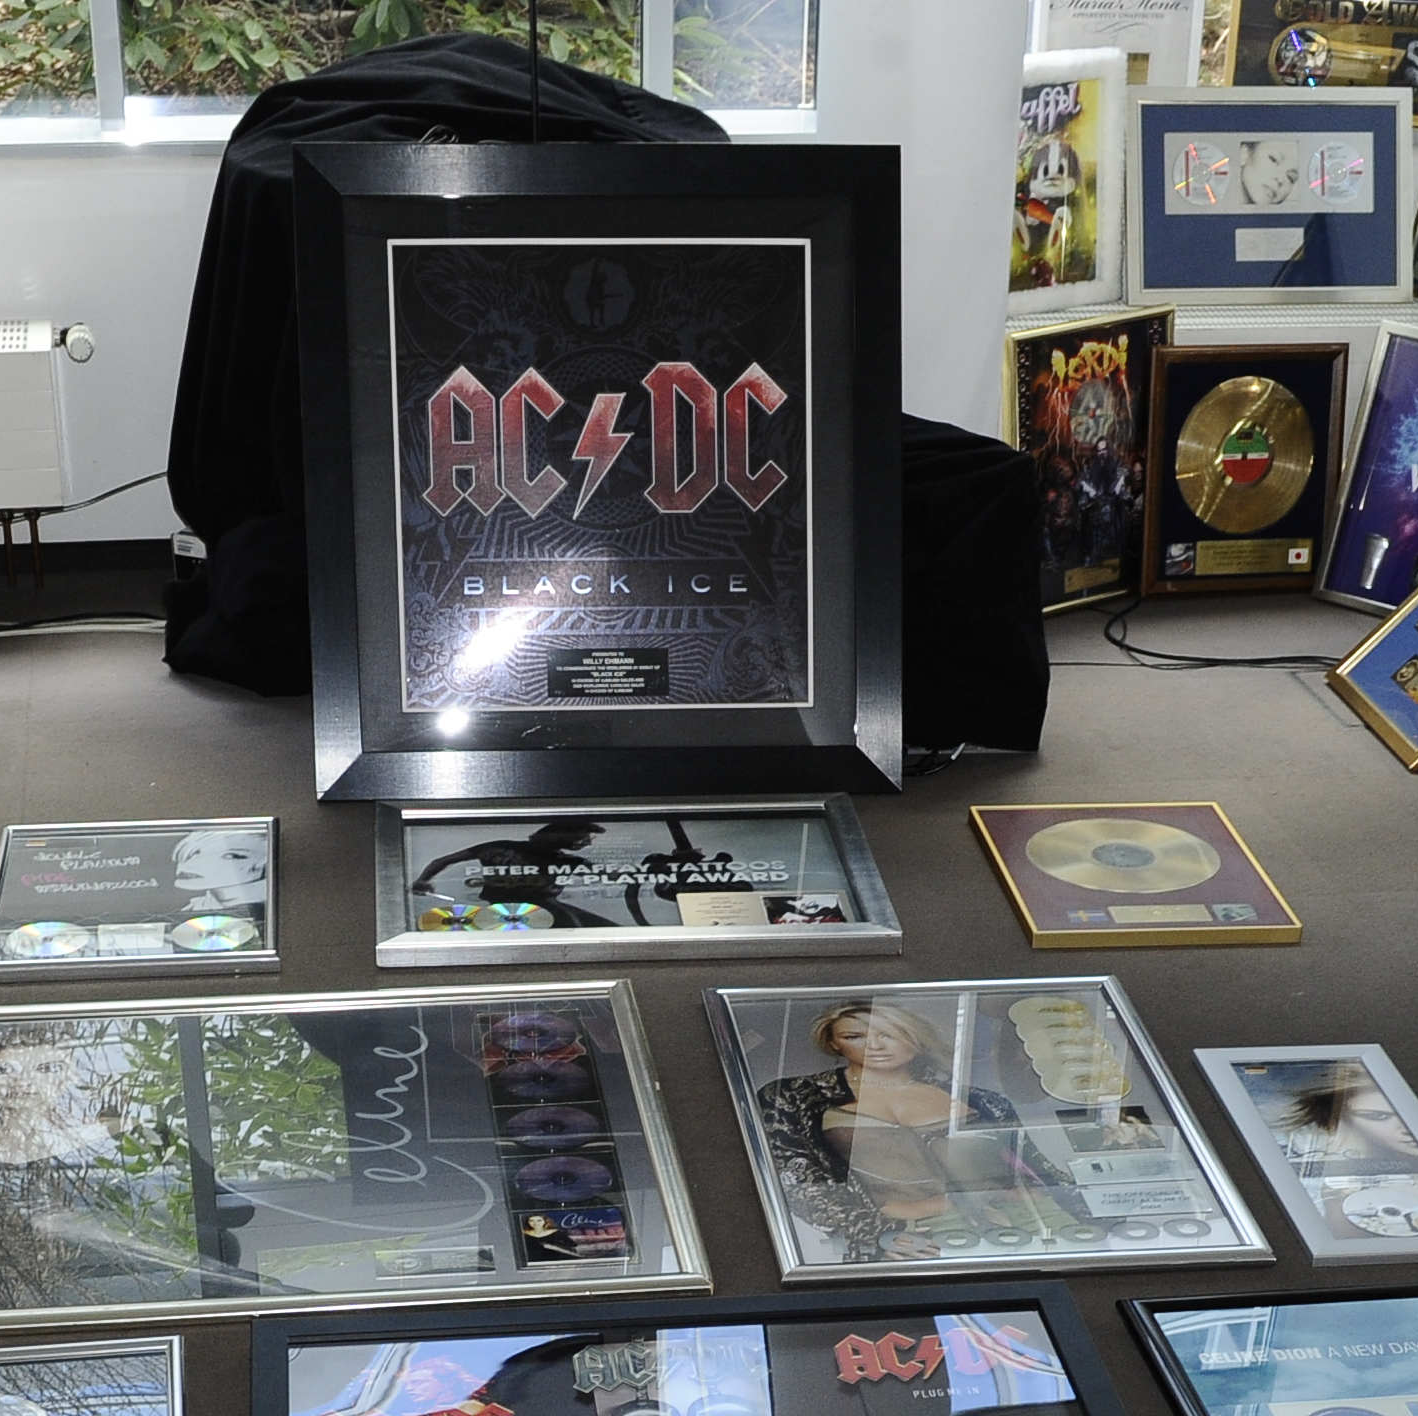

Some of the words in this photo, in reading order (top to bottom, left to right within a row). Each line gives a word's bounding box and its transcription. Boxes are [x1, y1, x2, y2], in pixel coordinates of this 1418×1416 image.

[463, 574, 631, 596] BLACK
[667, 573, 748, 593] ICE
[465, 865, 540, 876] PETER
[548, 862, 650, 875] MAFFAY
[667, 860, 786, 873] TATTOOS
[555, 874, 574, 886] &
[584, 872, 678, 885] PLATIN
[685, 870, 790, 883] AWARD
[1198, 1349, 1269, 1366] CELINE
[1273, 1347, 1322, 1362] DION
[1328, 1347, 1341, 1359] A
[1344, 1343, 1384, 1358] NEW
[912, 1389, 944, 1399] PLUG
